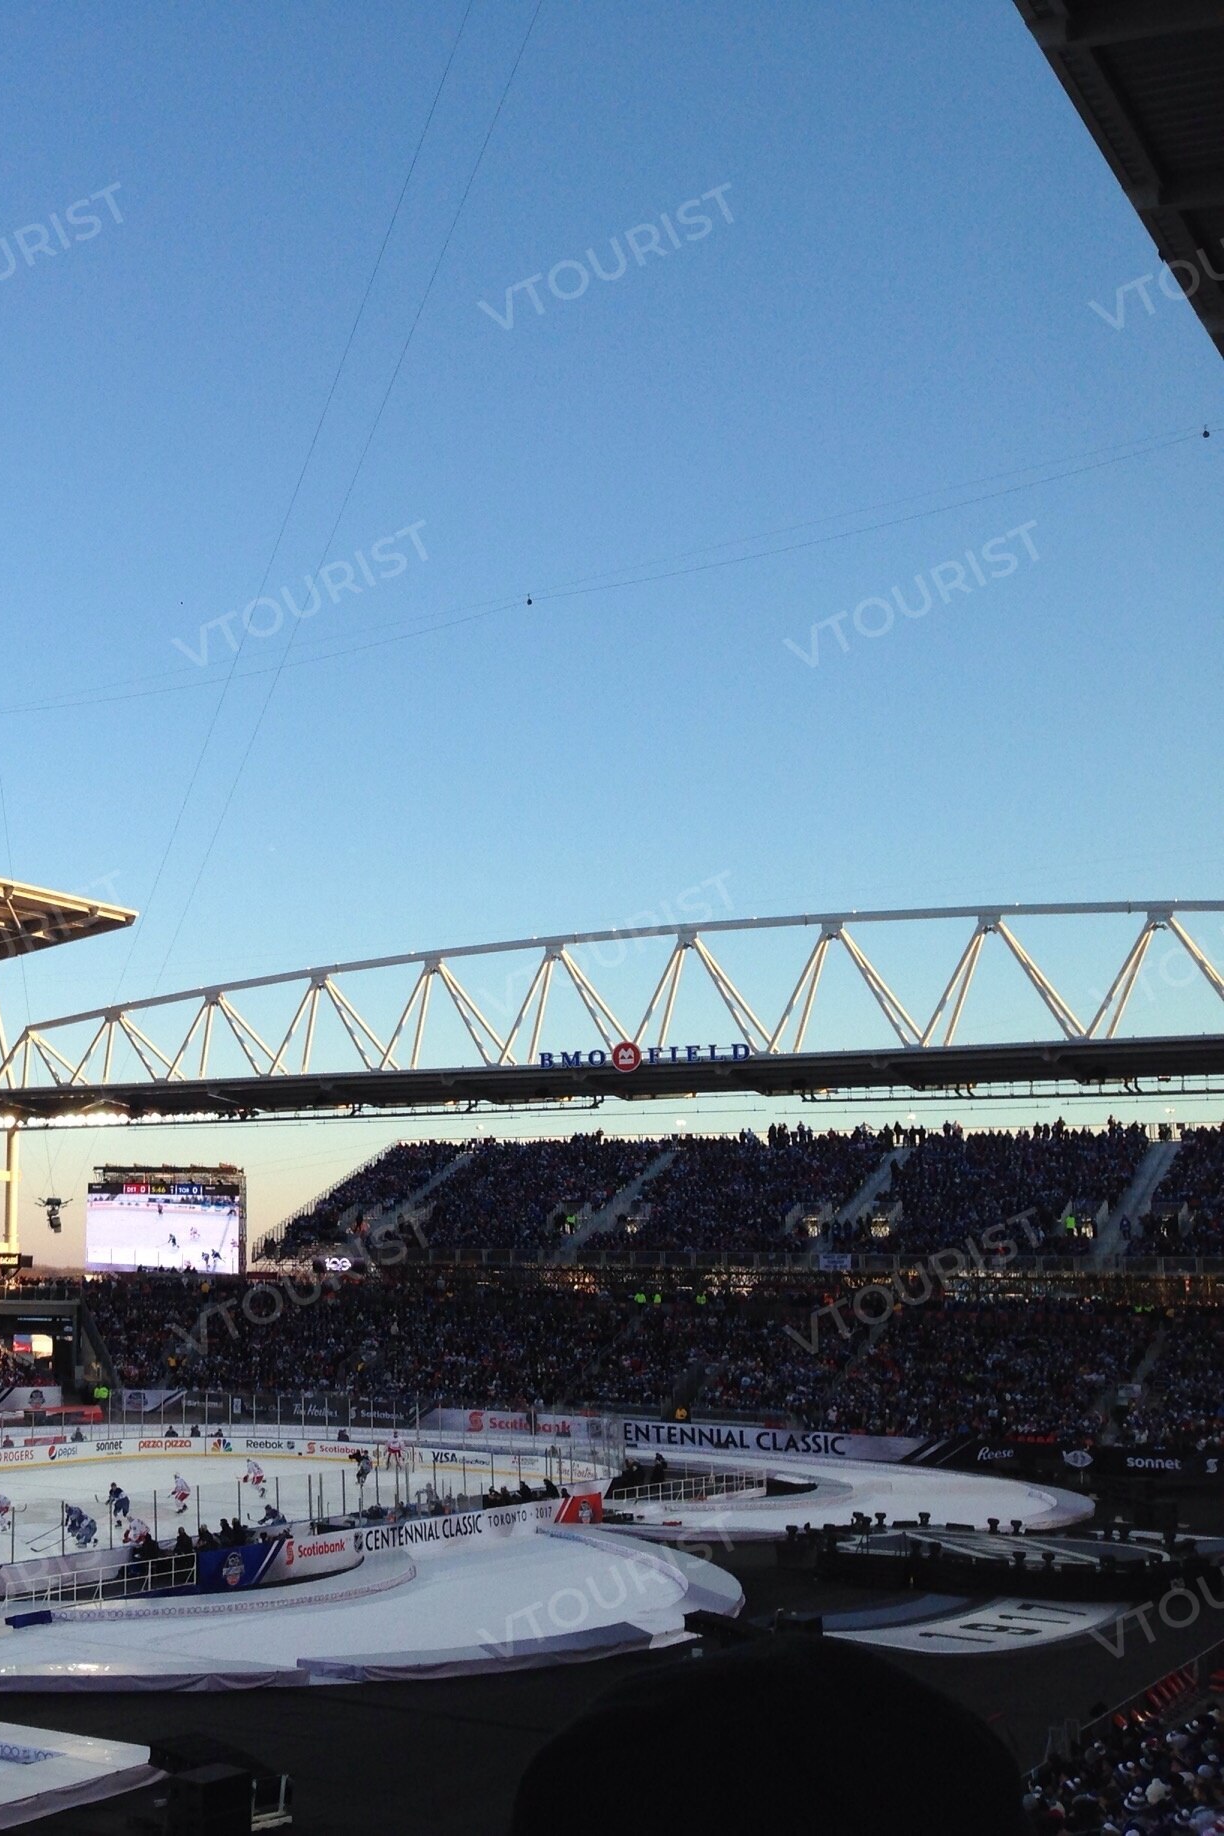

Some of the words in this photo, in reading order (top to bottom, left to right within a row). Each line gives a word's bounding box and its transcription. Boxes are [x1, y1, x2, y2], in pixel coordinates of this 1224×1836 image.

[539, 1050, 606, 1069] BMO
[648, 1044, 750, 1064] FIELD
[138, 1440, 163, 1451] pizza
[164, 1439, 192, 1451] pizza
[246, 1439, 283, 1449] Reebok
[624, 1422, 750, 1450] ENTENNIAL
[756, 1431, 846, 1455] CLASSIC
[58, 1446, 77, 1458] pepsi
[95, 1440, 123, 1451] sonnet
[3, 1449, 34, 1461] ROGERS
[432, 1451, 458, 1463] VISA
[977, 1447, 1014, 1461] Reese
[1127, 1457, 1181, 1470] sonnet
[365, 1522, 440, 1551] CENTENNIAL
[442, 1514, 482, 1538] CLASSIC
[487, 1509, 526, 1528] TORONTO
[535, 1506, 552, 1519] 2017
[298, 1539, 346, 1558] Scotiabank
[0, 1744, 19, 1757] 100
[34, 1751, 53, 1760] 100
